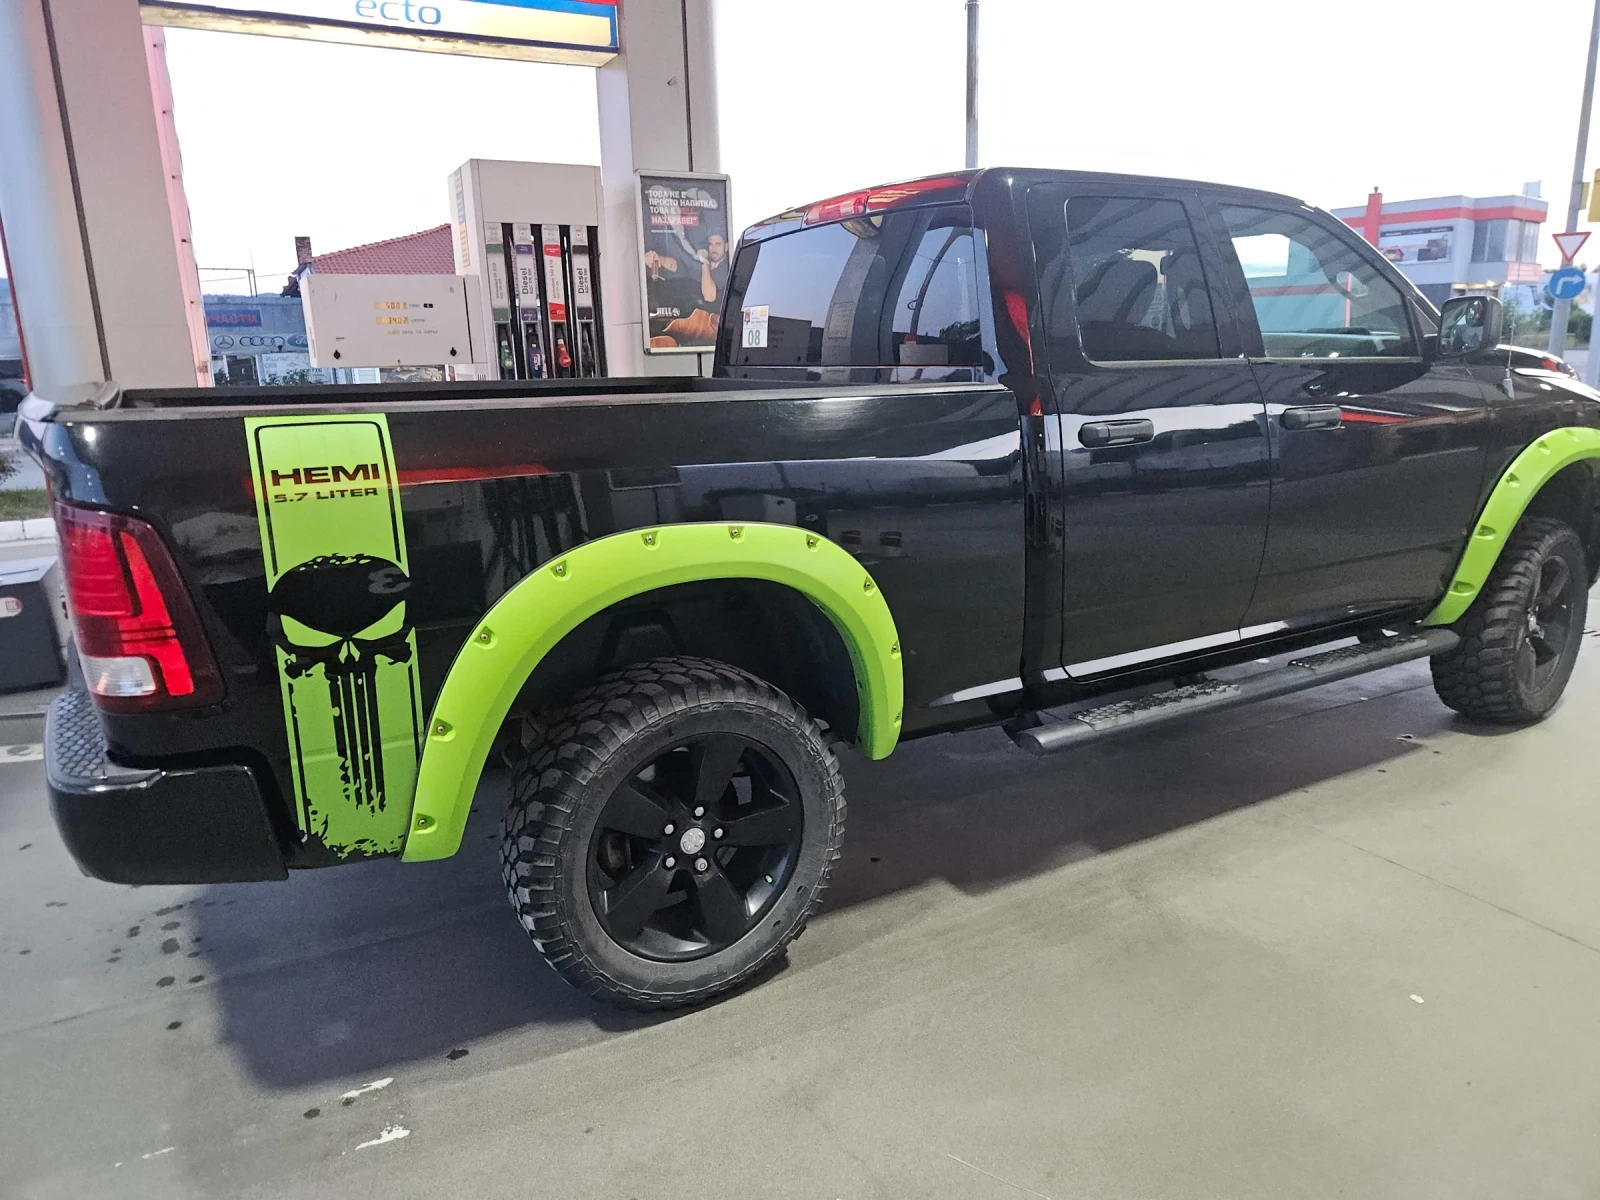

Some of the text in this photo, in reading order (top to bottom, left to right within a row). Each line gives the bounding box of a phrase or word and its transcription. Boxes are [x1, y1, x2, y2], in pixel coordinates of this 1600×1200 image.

[354, 0, 442, 25] ecto
[648, 198, 679, 207] ПРОСТО
[649, 206, 669, 215] ТОВА
[520, 268, 528, 294] Diesel
[576, 268, 585, 294] Diesel
[747, 329, 761, 346] 08
[270, 463, 381, 486] HEMI
[273, 487, 378, 503] 5.7 LITER
